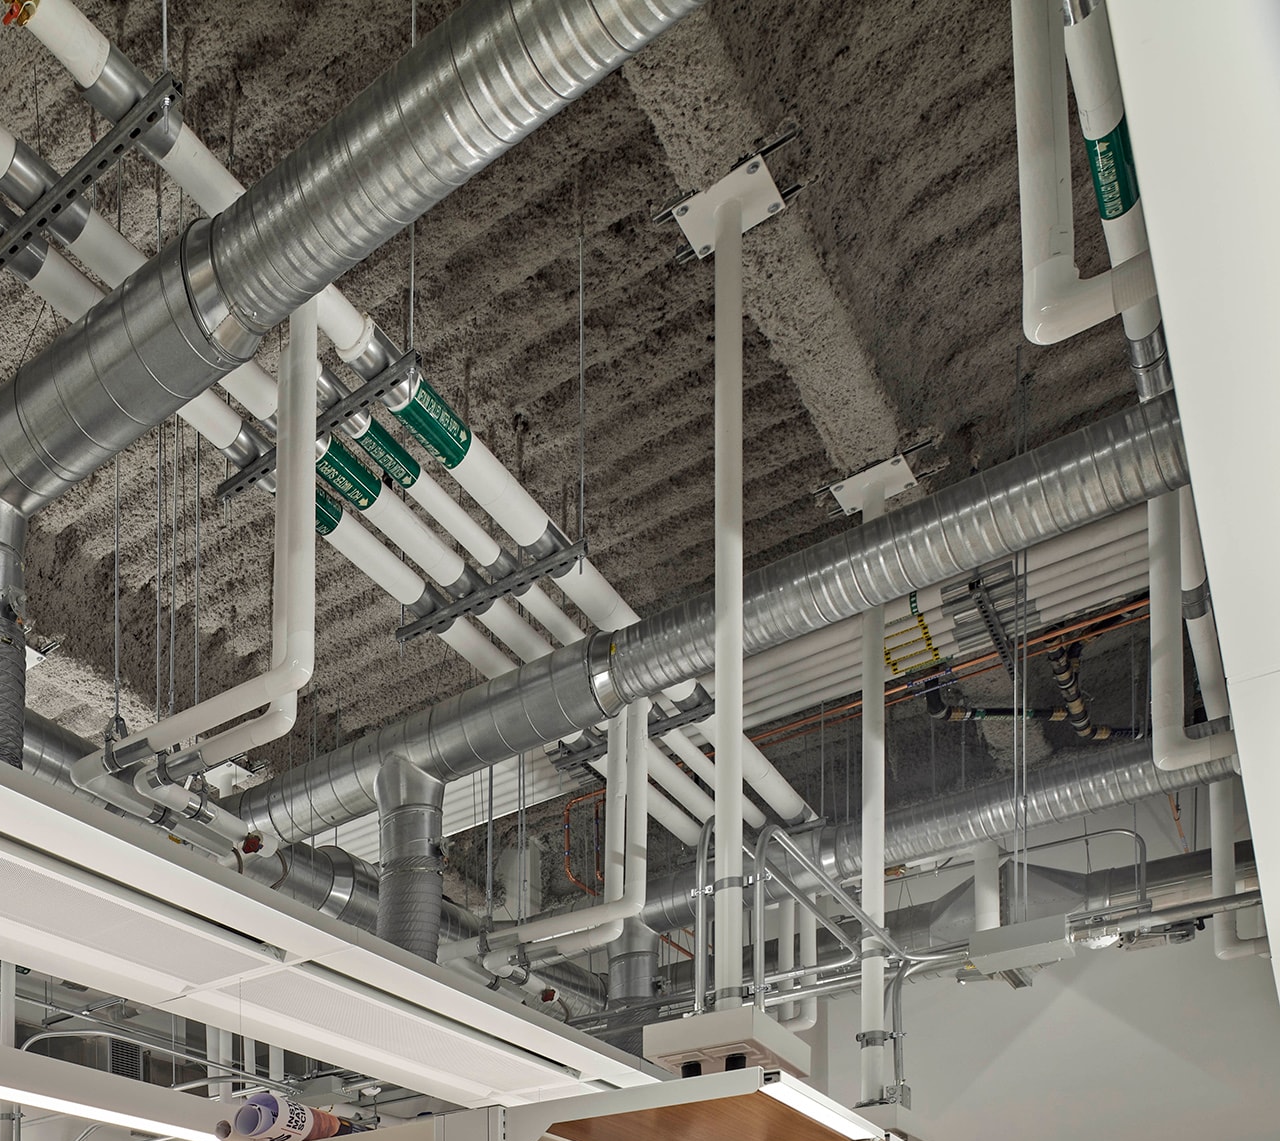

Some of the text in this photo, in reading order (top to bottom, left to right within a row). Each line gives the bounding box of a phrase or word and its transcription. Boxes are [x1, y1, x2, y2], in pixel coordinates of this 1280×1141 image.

[315, 459, 339, 479] SUPPLY
[332, 473, 353, 493] WATER
[346, 487, 363, 502] HOT
